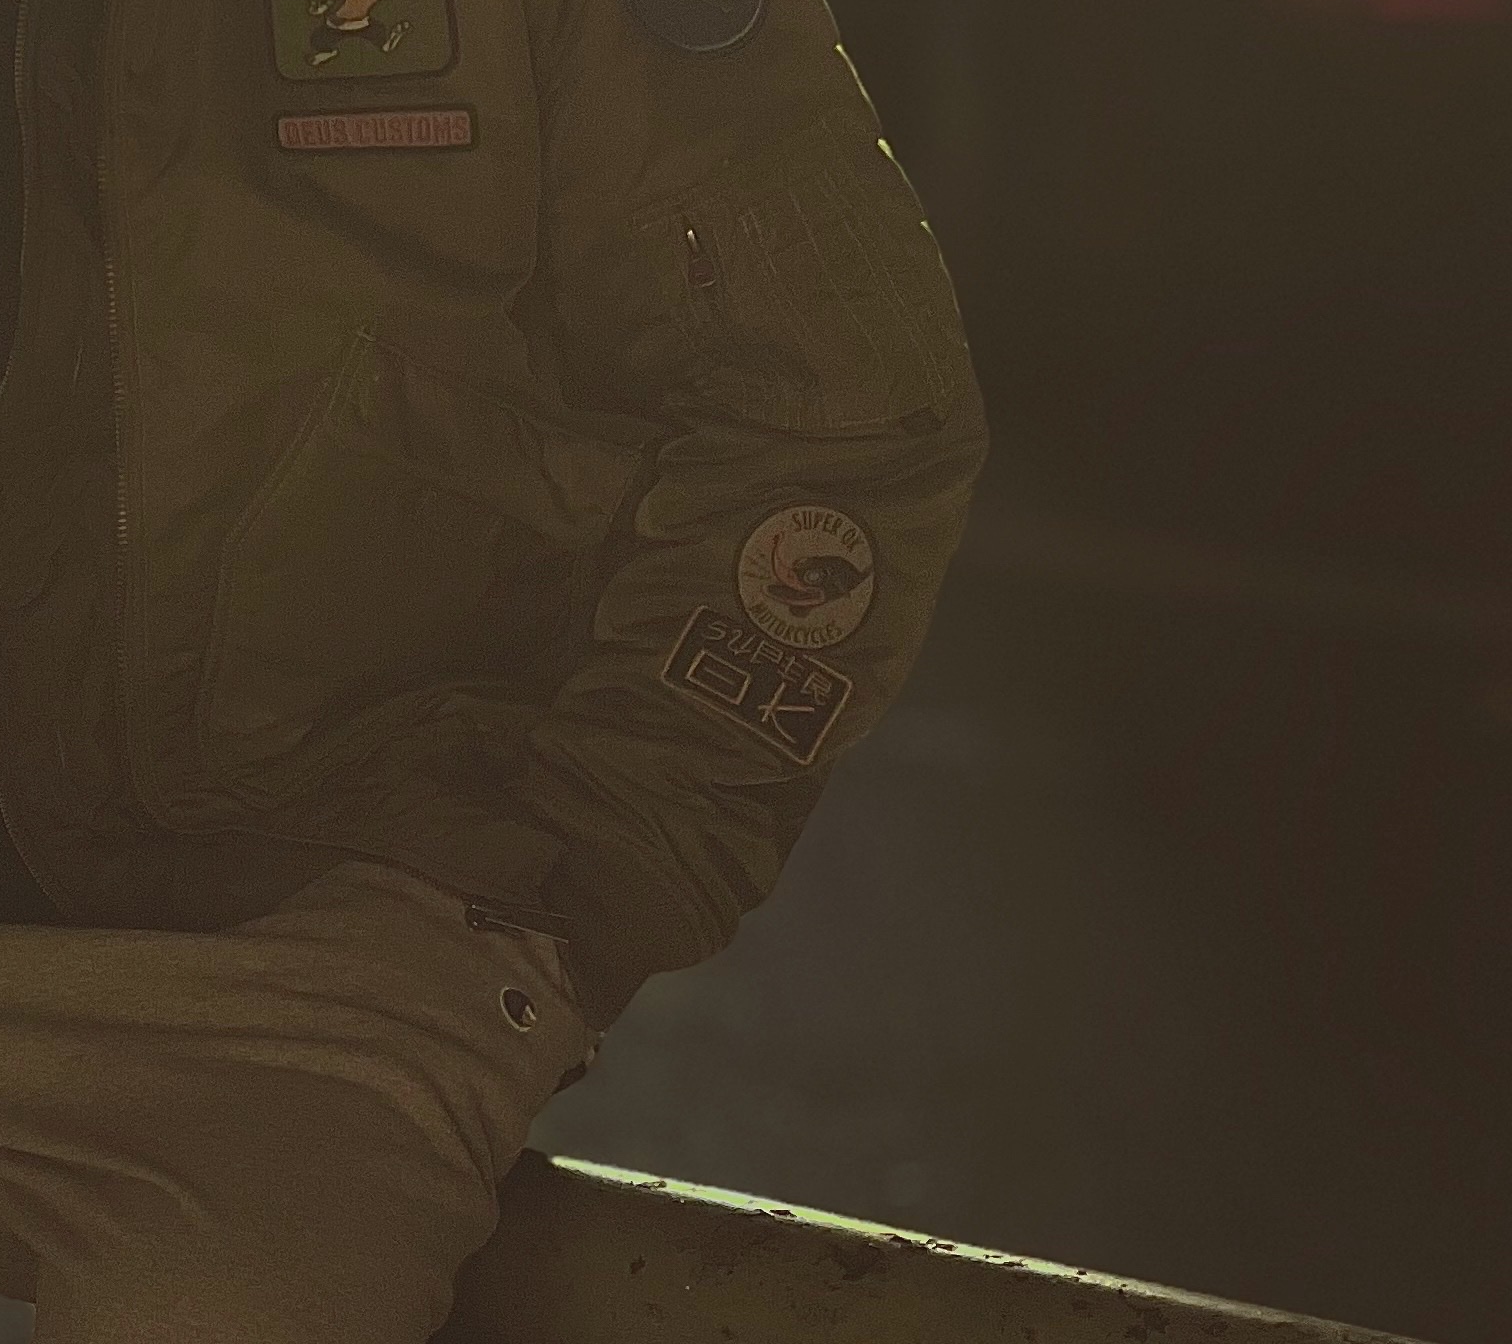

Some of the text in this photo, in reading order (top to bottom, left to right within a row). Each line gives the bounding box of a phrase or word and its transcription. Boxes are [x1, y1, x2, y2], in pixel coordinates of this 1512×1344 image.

[284, 115, 468, 145] DEUS CUSTOMS
[792, 510, 840, 533] SUPER
[752, 602, 845, 645] MOTORCYCLES
[702, 621, 832, 705] SUPER
